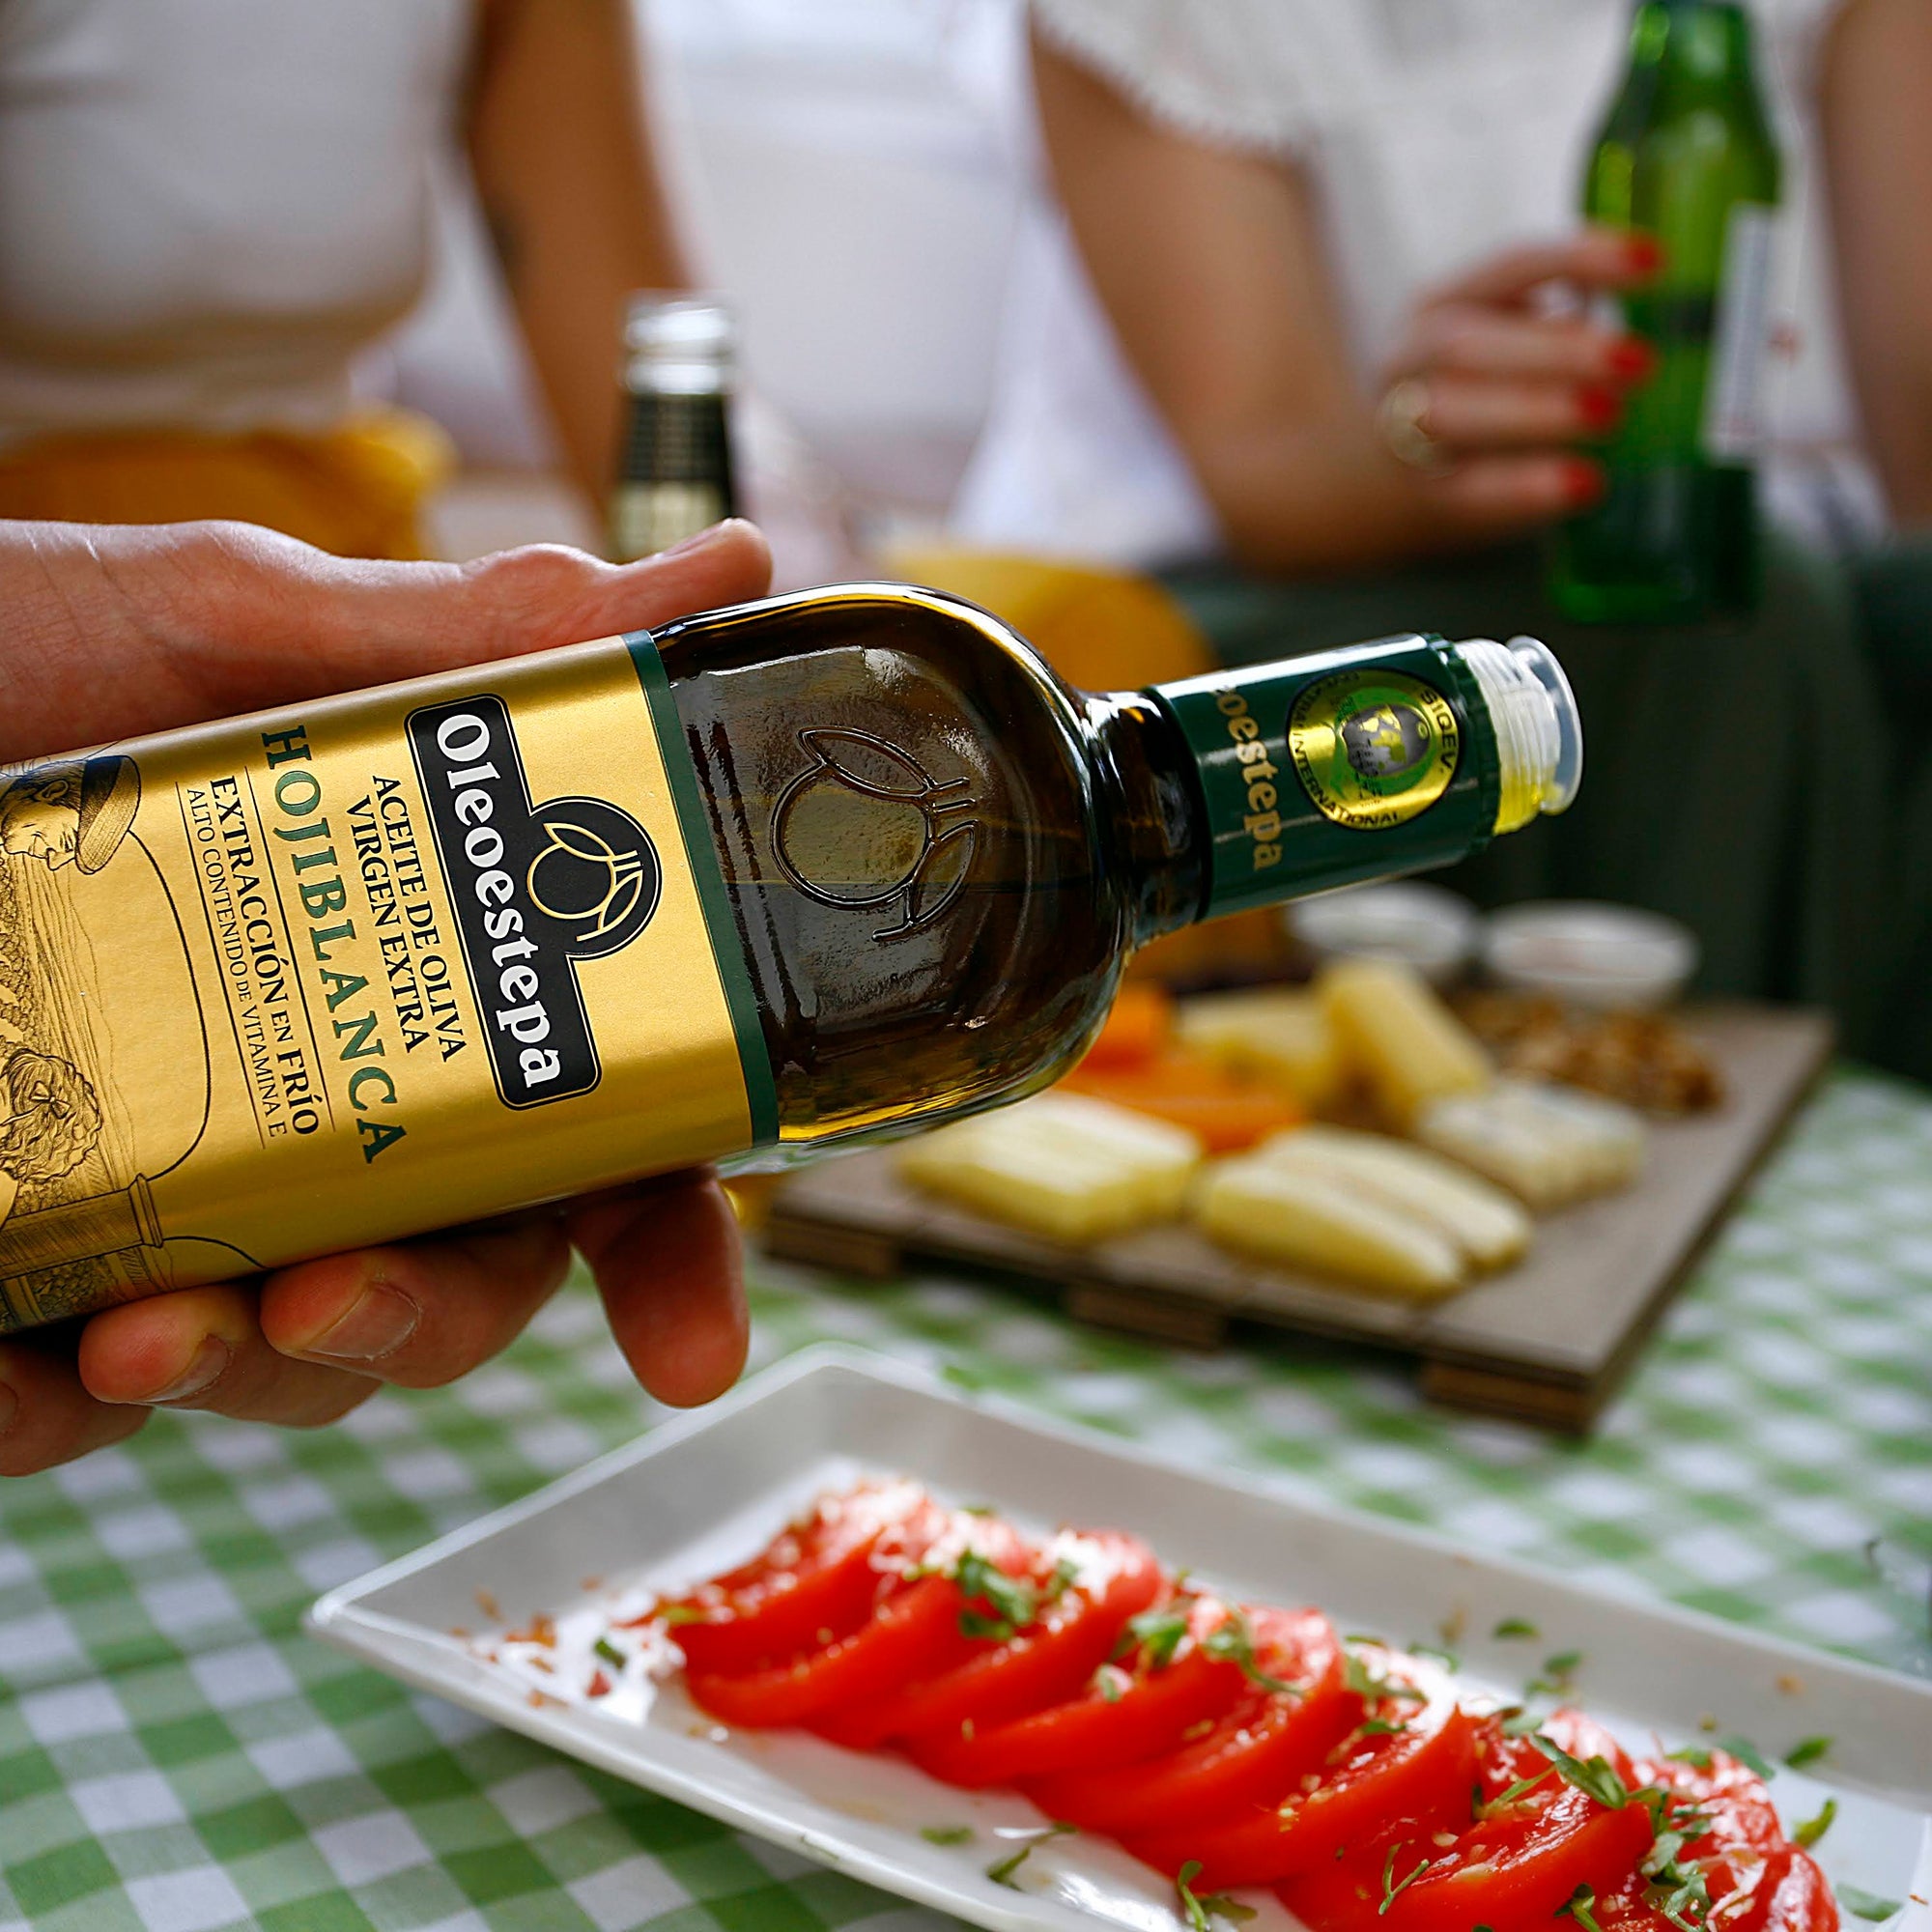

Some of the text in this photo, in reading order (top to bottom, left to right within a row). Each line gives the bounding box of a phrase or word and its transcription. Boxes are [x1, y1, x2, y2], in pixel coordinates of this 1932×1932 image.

[186, 788, 288, 1138] ALTO CONTENIDO DE VITAMINA E
[210, 776, 323, 1135] EXTRACCIÓN EN FRÍO
[261, 724, 407, 1164] HOJIBLANCA
[346, 794, 431, 1054] VIRGEN EXTRA
[373, 775, 468, 1063] ACEITE DE OLIVA
[437, 713, 562, 1089] Oleoestepa
